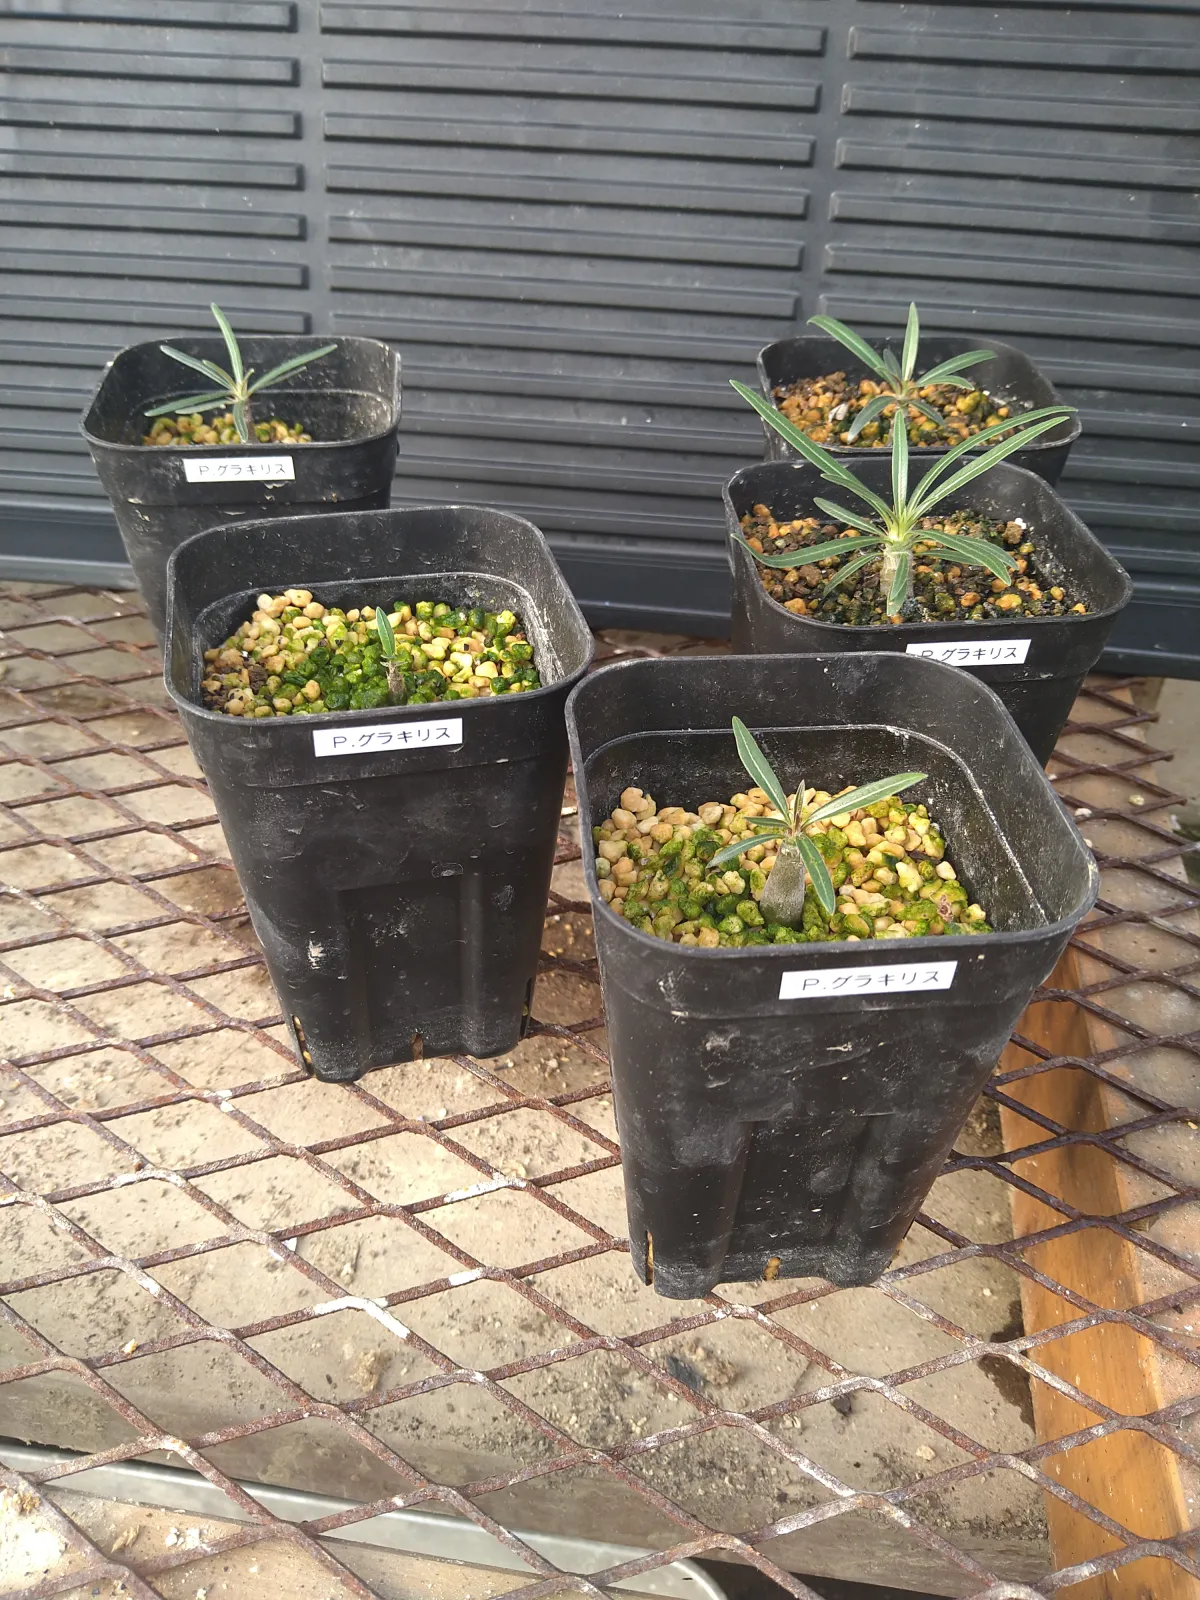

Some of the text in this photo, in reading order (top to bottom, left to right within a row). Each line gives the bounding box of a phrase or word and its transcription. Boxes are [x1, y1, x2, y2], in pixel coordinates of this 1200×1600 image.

[199, 463, 286, 476] P.グラキリス
[332, 727, 450, 748] P.グラキリス
[802, 970, 939, 991] P.グラキリス
